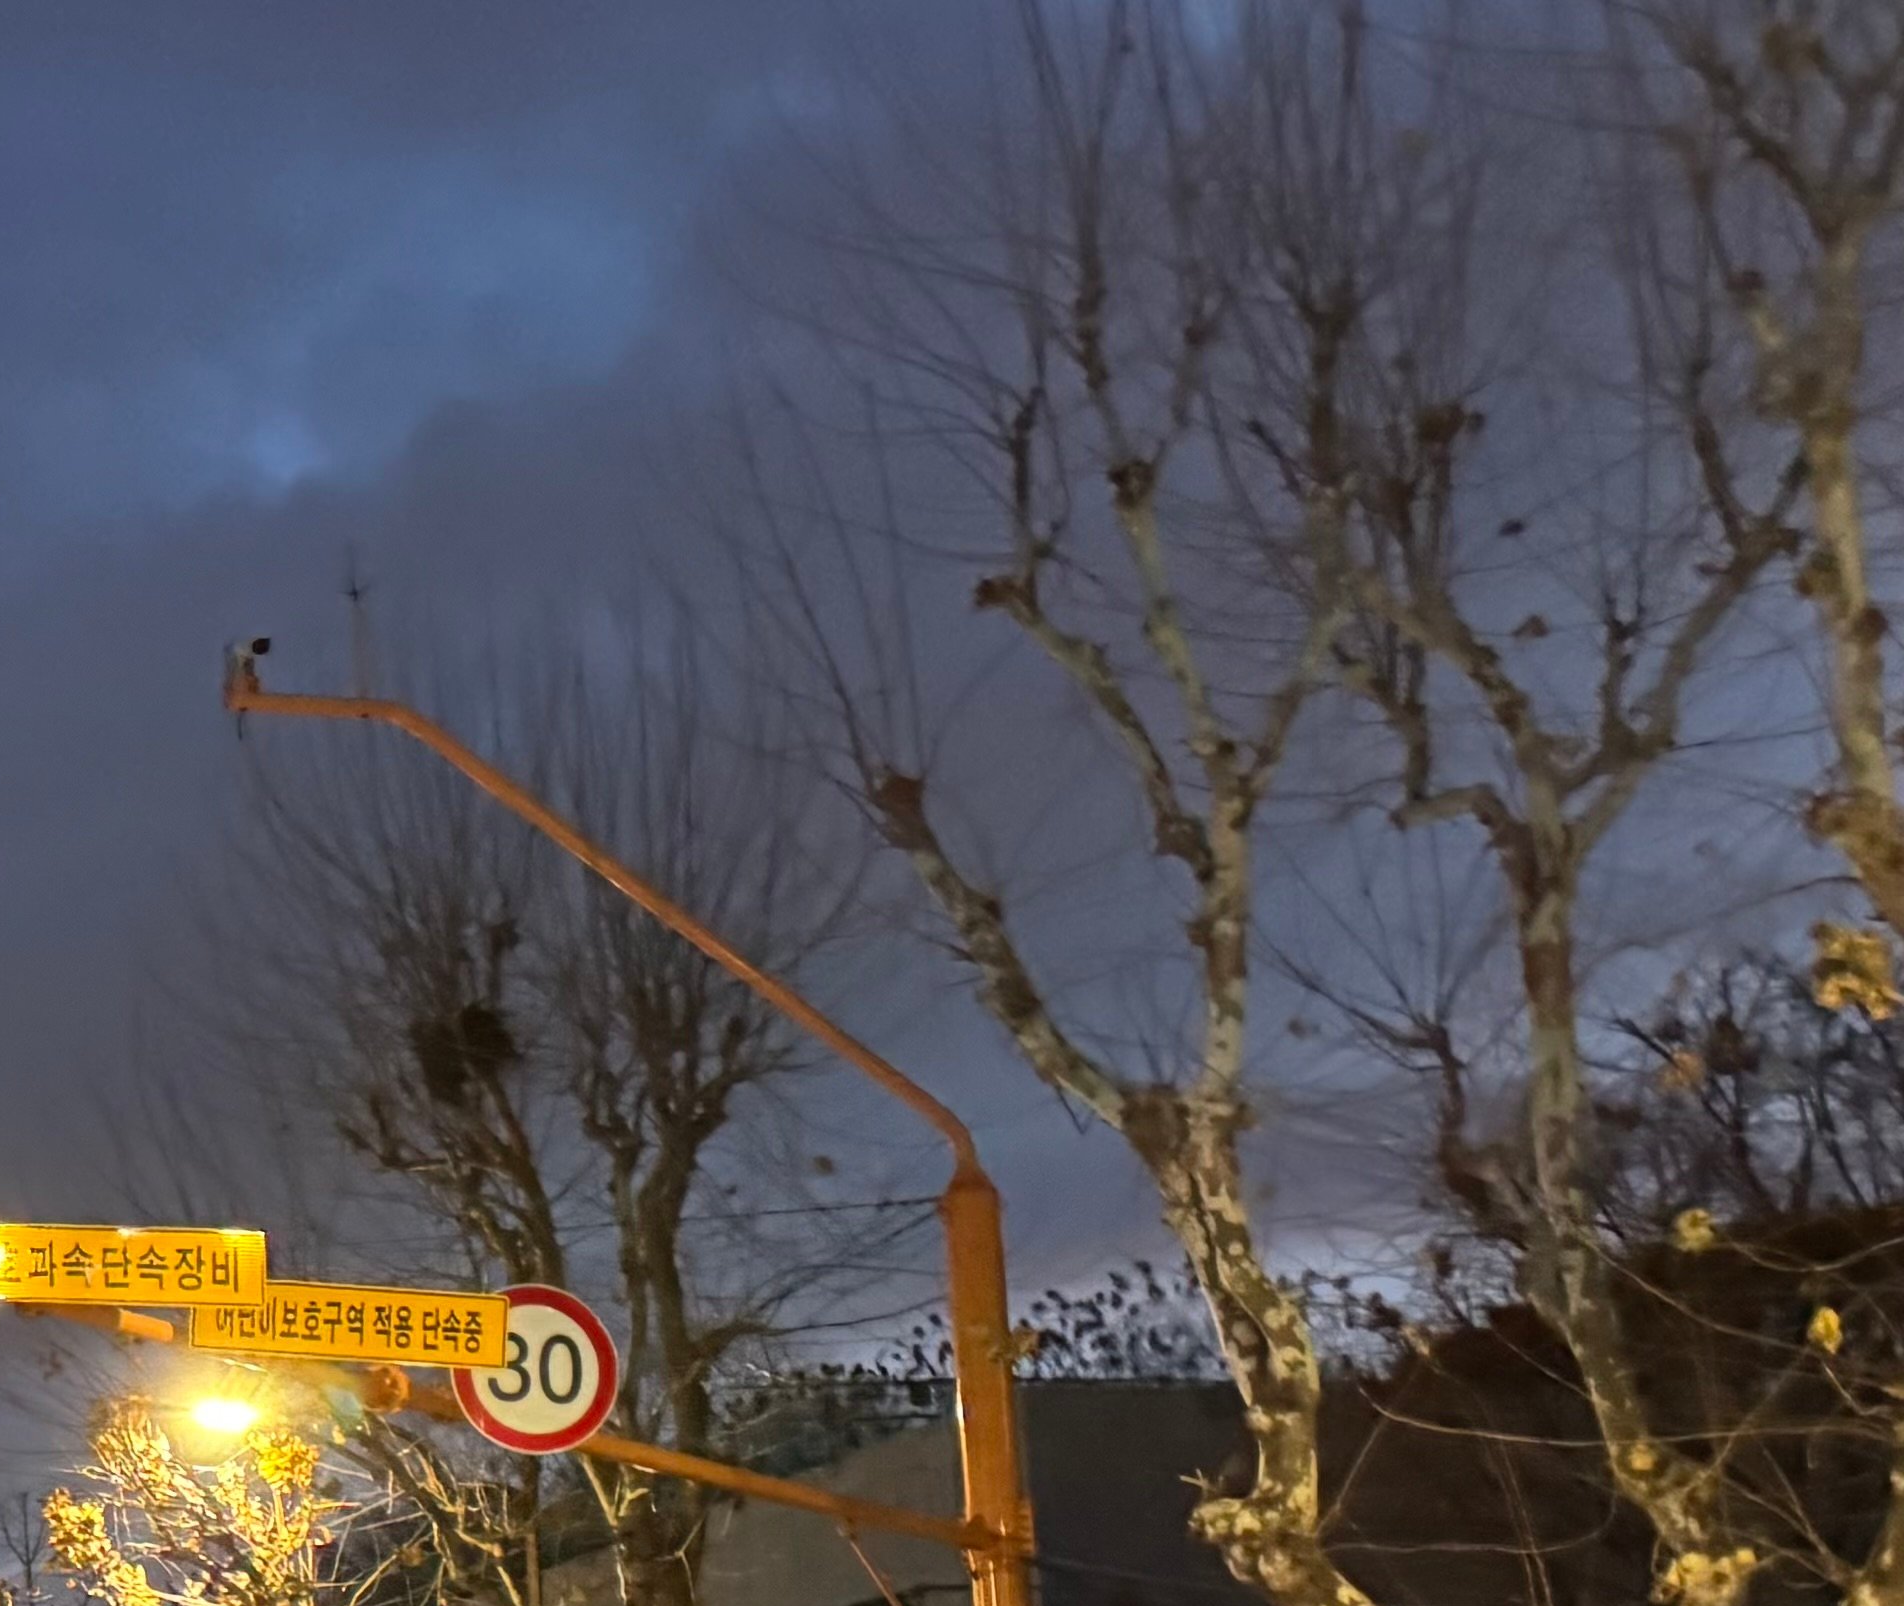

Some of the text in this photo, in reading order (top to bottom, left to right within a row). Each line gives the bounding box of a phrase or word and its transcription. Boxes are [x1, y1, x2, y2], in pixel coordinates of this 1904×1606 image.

[28, 1240, 240, 1294] 과속단속장비
[371, 1304, 414, 1350] 적용
[422, 1307, 484, 1355] 단속중
[488, 1331, 583, 1404] 30
